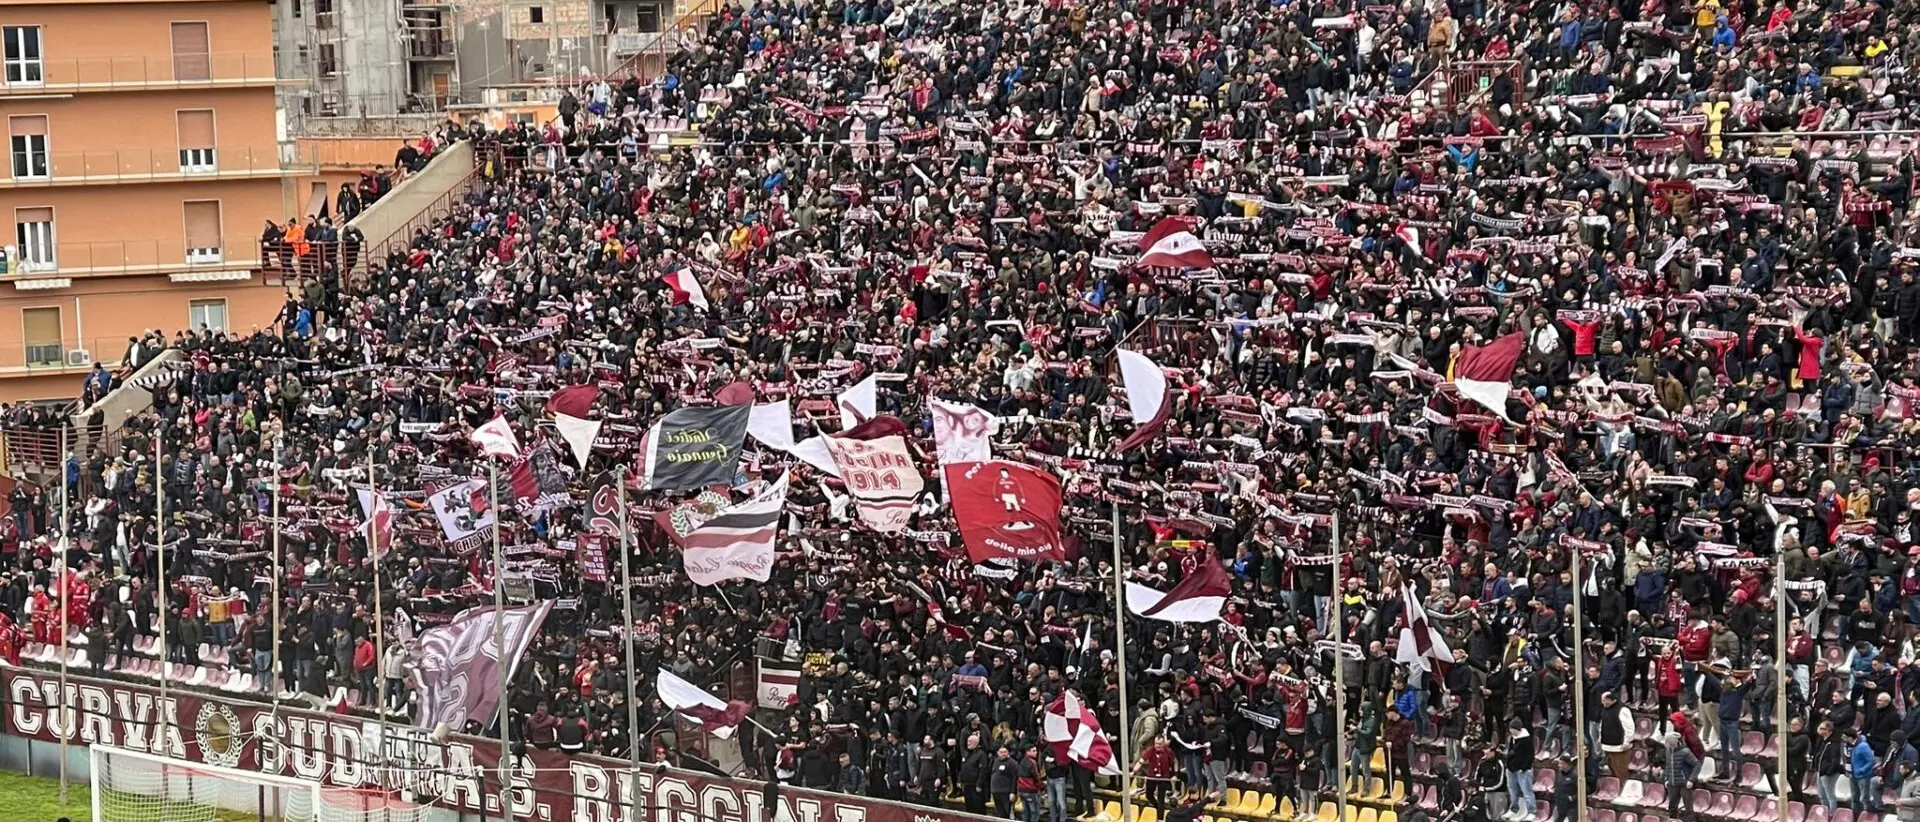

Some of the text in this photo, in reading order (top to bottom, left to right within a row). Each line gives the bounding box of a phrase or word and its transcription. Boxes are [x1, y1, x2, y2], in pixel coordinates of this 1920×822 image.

[843, 469, 901, 491] 1914
[984, 537, 1015, 553] della
[1017, 545, 1037, 556] mia
[10, 675, 188, 760] CURVA
[252, 710, 364, 788] SUD
